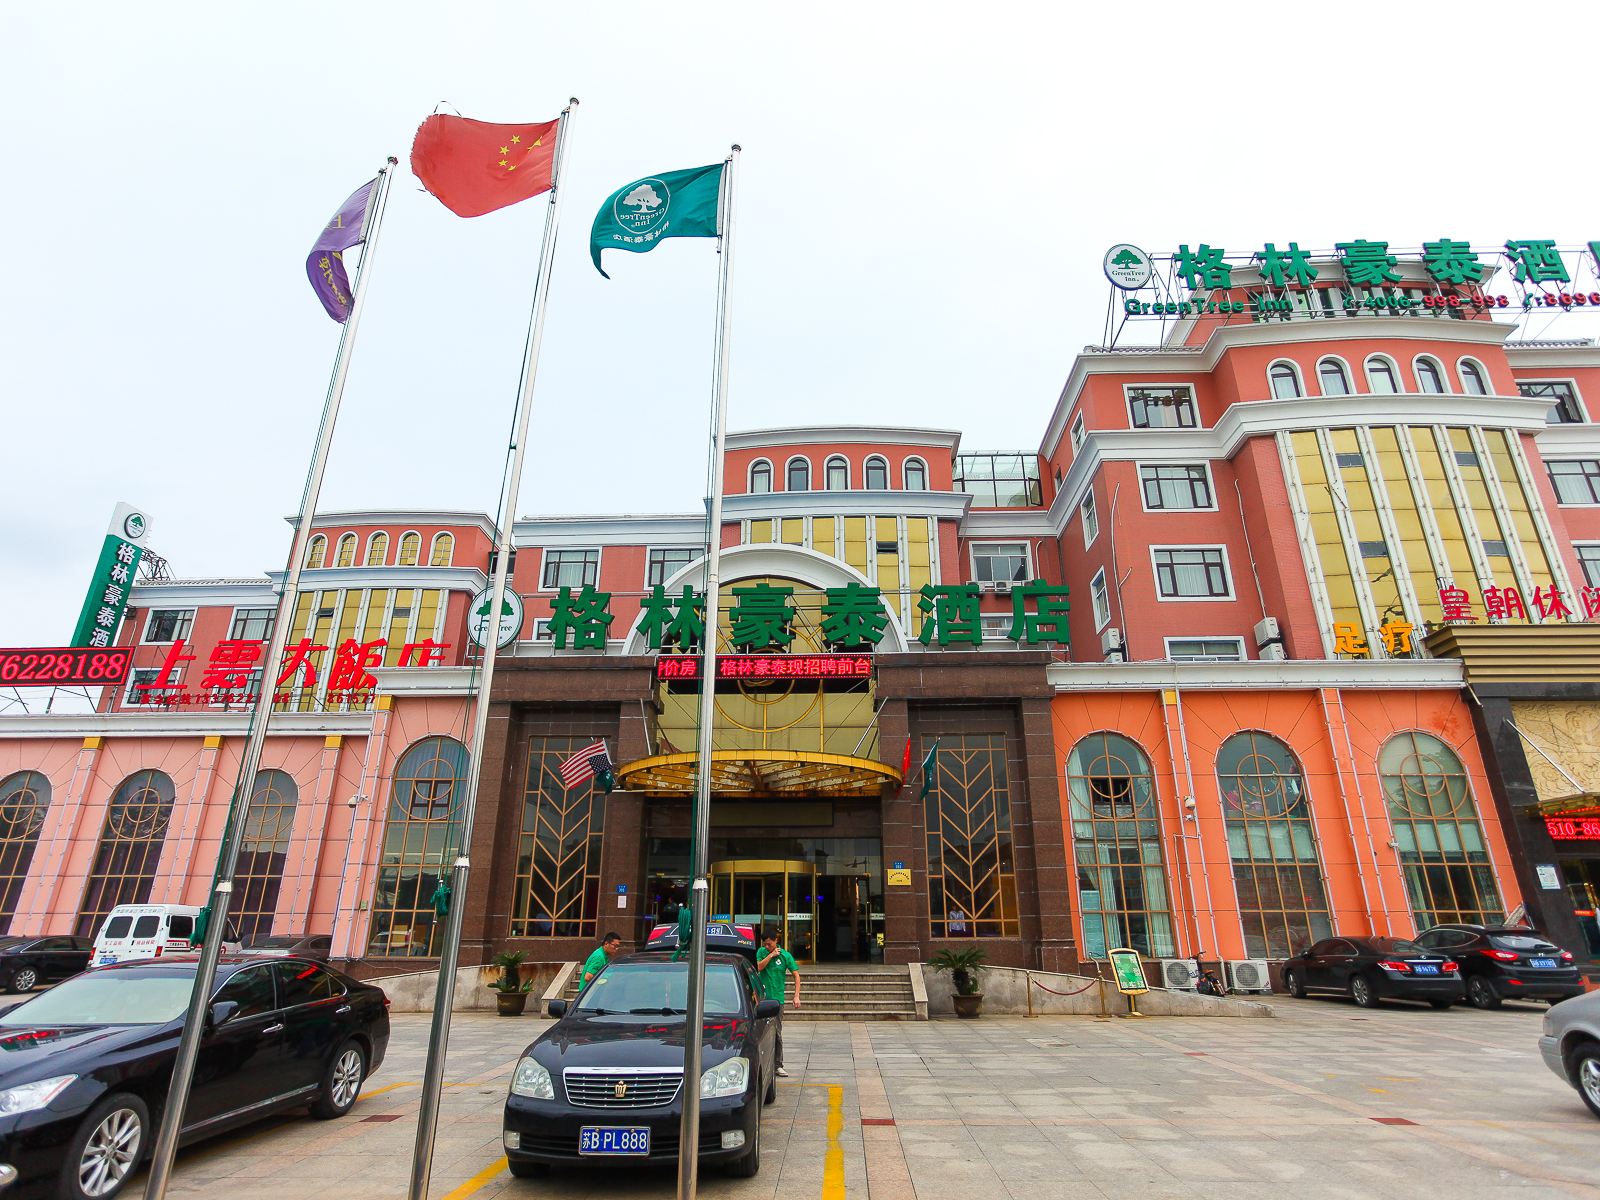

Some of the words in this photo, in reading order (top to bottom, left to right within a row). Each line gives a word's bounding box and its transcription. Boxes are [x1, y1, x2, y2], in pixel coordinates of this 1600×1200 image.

[1125, 297, 1245, 315] GreenTree
[1257, 295, 1294, 313] Inn
[89, 541, 137, 648] 格林豪泰酒
[473, 624, 513, 632] Greree
[546, 579, 1071, 650] 格林豪泰酒店
[1333, 620, 1413, 654] 足疗
